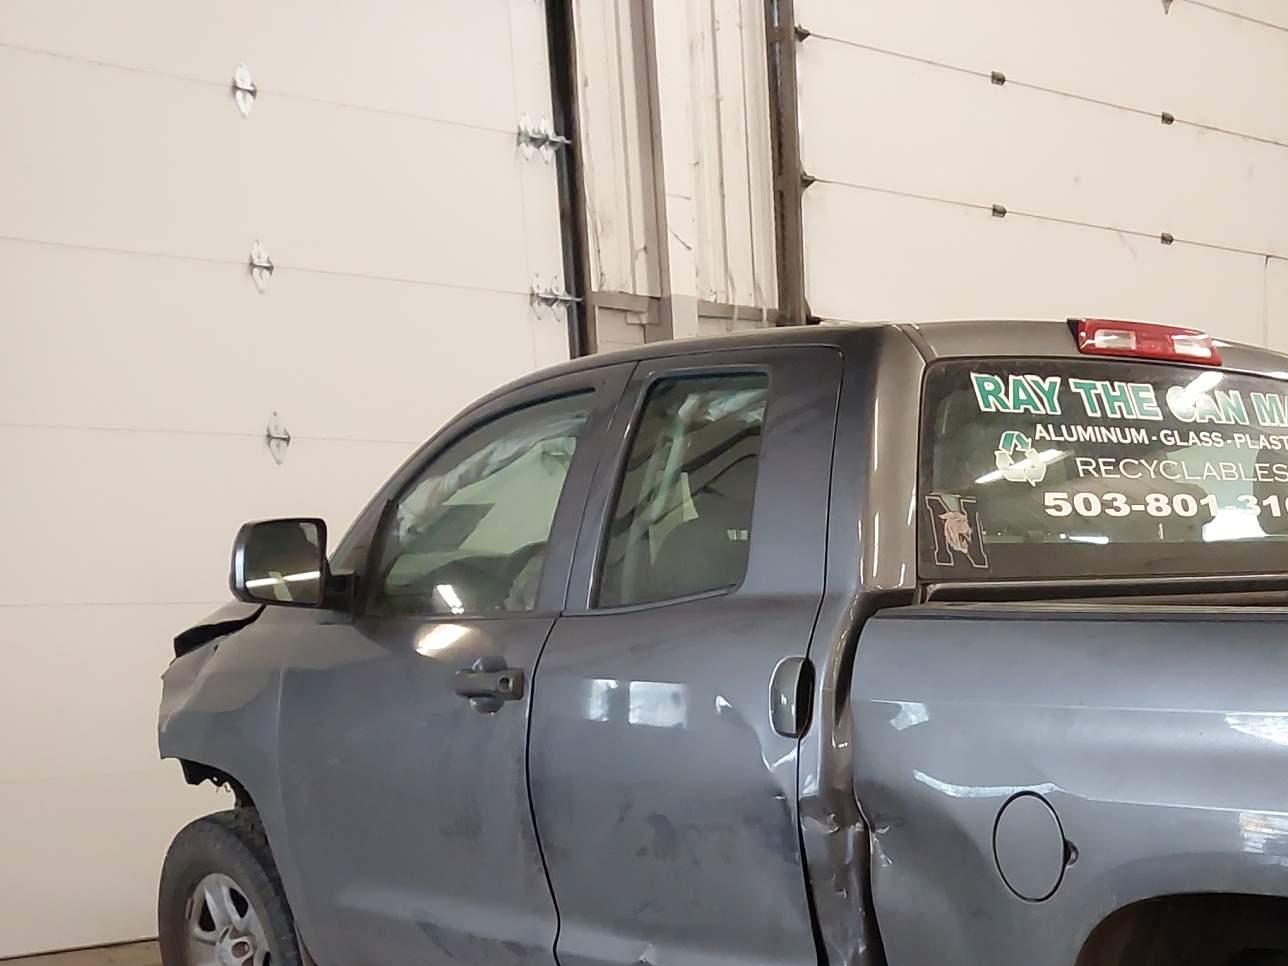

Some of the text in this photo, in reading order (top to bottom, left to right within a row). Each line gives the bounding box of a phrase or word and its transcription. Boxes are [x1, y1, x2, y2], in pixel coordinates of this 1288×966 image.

[970, 372, 1062, 416] RAY
[1068, 378, 1163, 421] THE
[1166, 386, 1250, 426] CAN
[1035, 423, 1149, 445] ALUMINUM
[1159, 429, 1224, 448] GLASS
